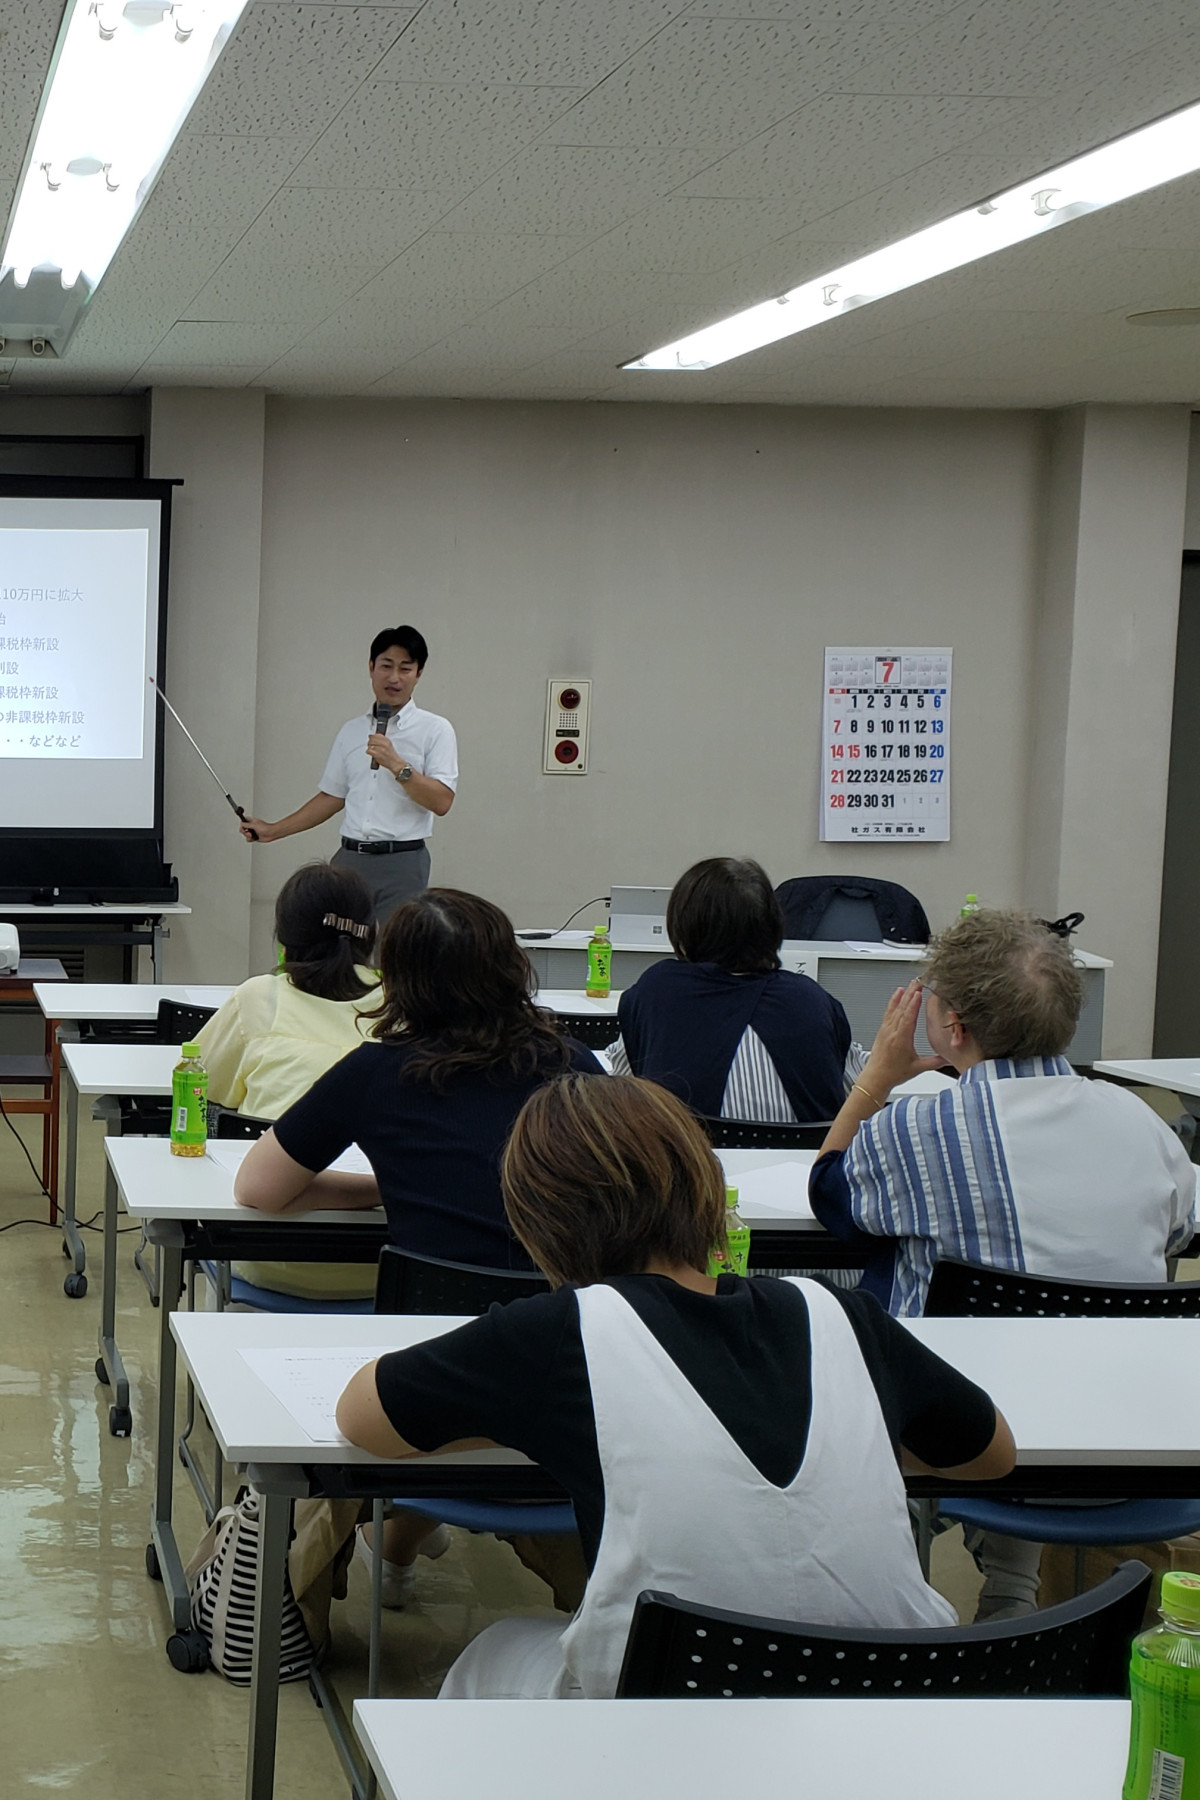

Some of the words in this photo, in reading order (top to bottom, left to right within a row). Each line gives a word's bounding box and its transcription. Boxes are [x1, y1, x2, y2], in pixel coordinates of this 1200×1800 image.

[882, 662, 895, 683] 7
[851, 695, 857, 709] 1
[867, 695, 875, 709] 2
[884, 695, 892, 709] 3
[900, 695, 908, 709] 4
[917, 695, 925, 709] 5
[933, 695, 942, 709] 6
[833, 720, 841, 733] 7
[850, 720, 858, 733] 8
[867, 720, 875, 733] 9
[881, 720, 894, 733] 10
[898, 720, 910, 733] 11
[914, 720, 927, 733] 12
[931, 720, 944, 733] 13
[830, 745, 844, 758] 14
[847, 745, 860, 758] 15
[864, 745, 877, 758] 16
[881, 745, 894, 758] 17
[898, 745, 910, 758] 18
[914, 745, 927, 758] 19
[929, 745, 944, 758] 20
[831, 769, 844, 783] 21
[847, 769, 862, 783] 22
[863, 769, 878, 783] 23
[880, 769, 895, 783] 24
[896, 769, 911, 783] 25
[913, 769, 928, 783] 26
[929, 769, 944, 783] 27
[830, 794, 845, 808] 28
[847, 794, 862, 808] 29
[864, 794, 878, 808] 30
[881, 794, 895, 808] 31
